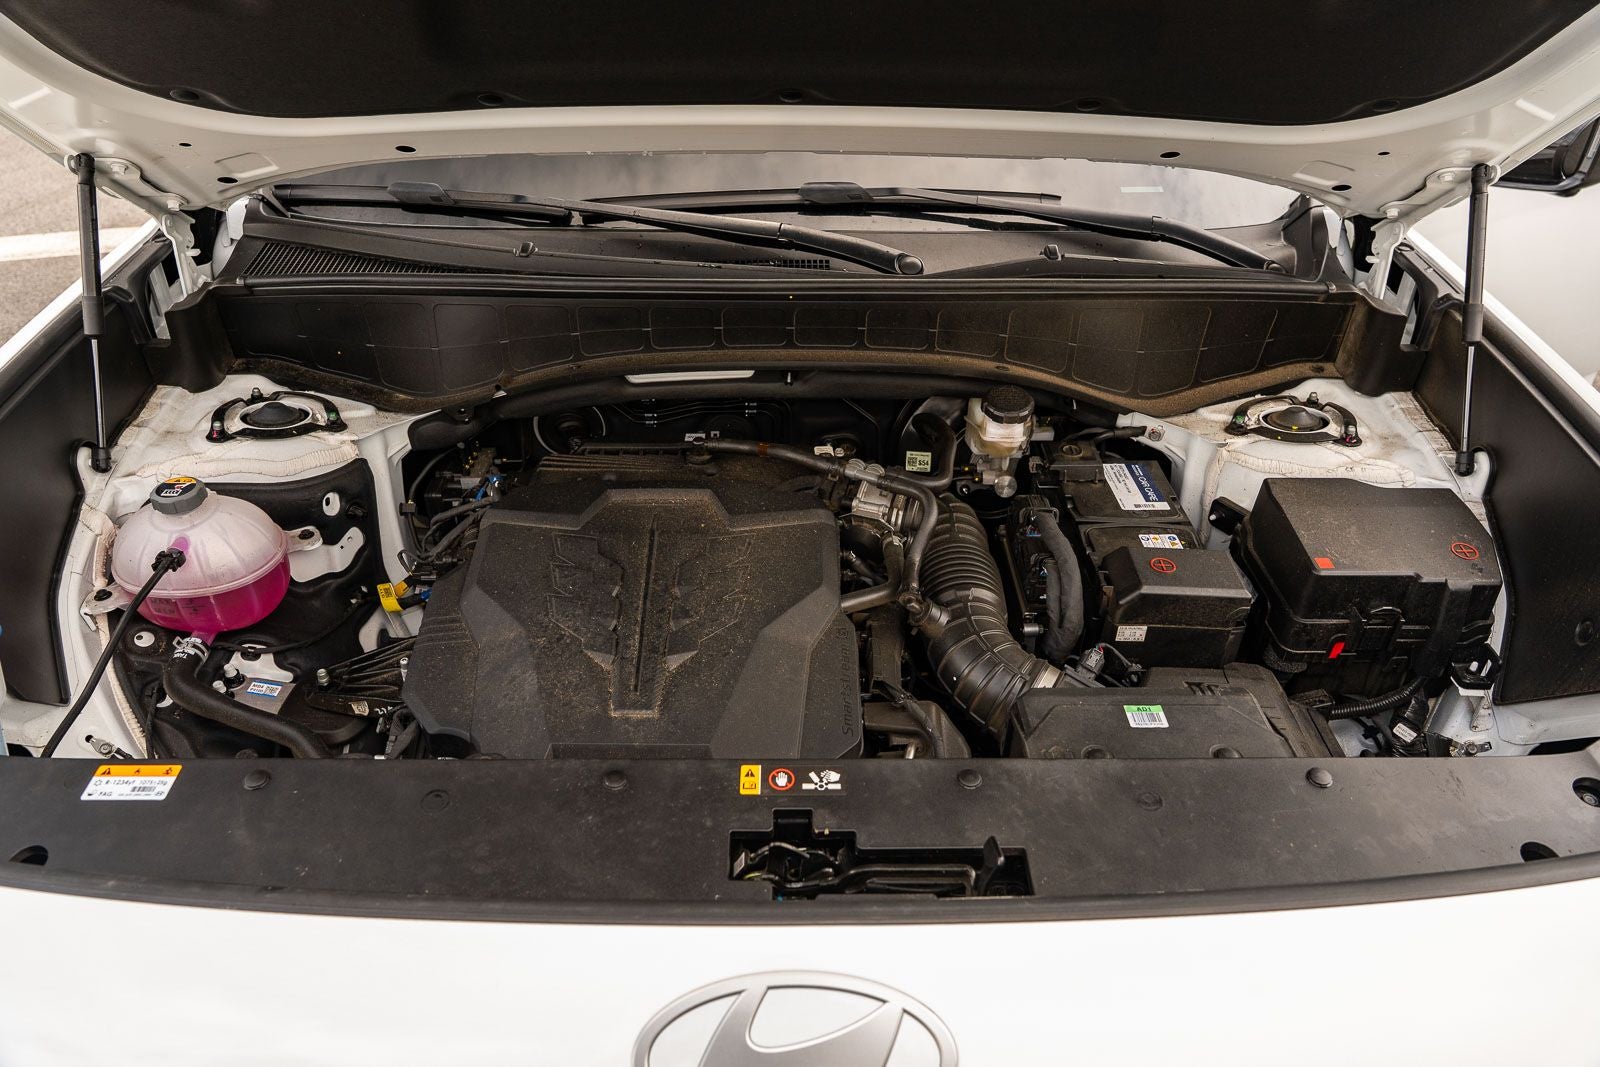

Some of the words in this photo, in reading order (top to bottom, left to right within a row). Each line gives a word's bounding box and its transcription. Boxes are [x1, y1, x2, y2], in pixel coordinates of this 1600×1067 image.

[1138, 476, 1150, 488] CAR
[1144, 487, 1159, 502] CARE
[840, 639, 854, 737] Smartstream
